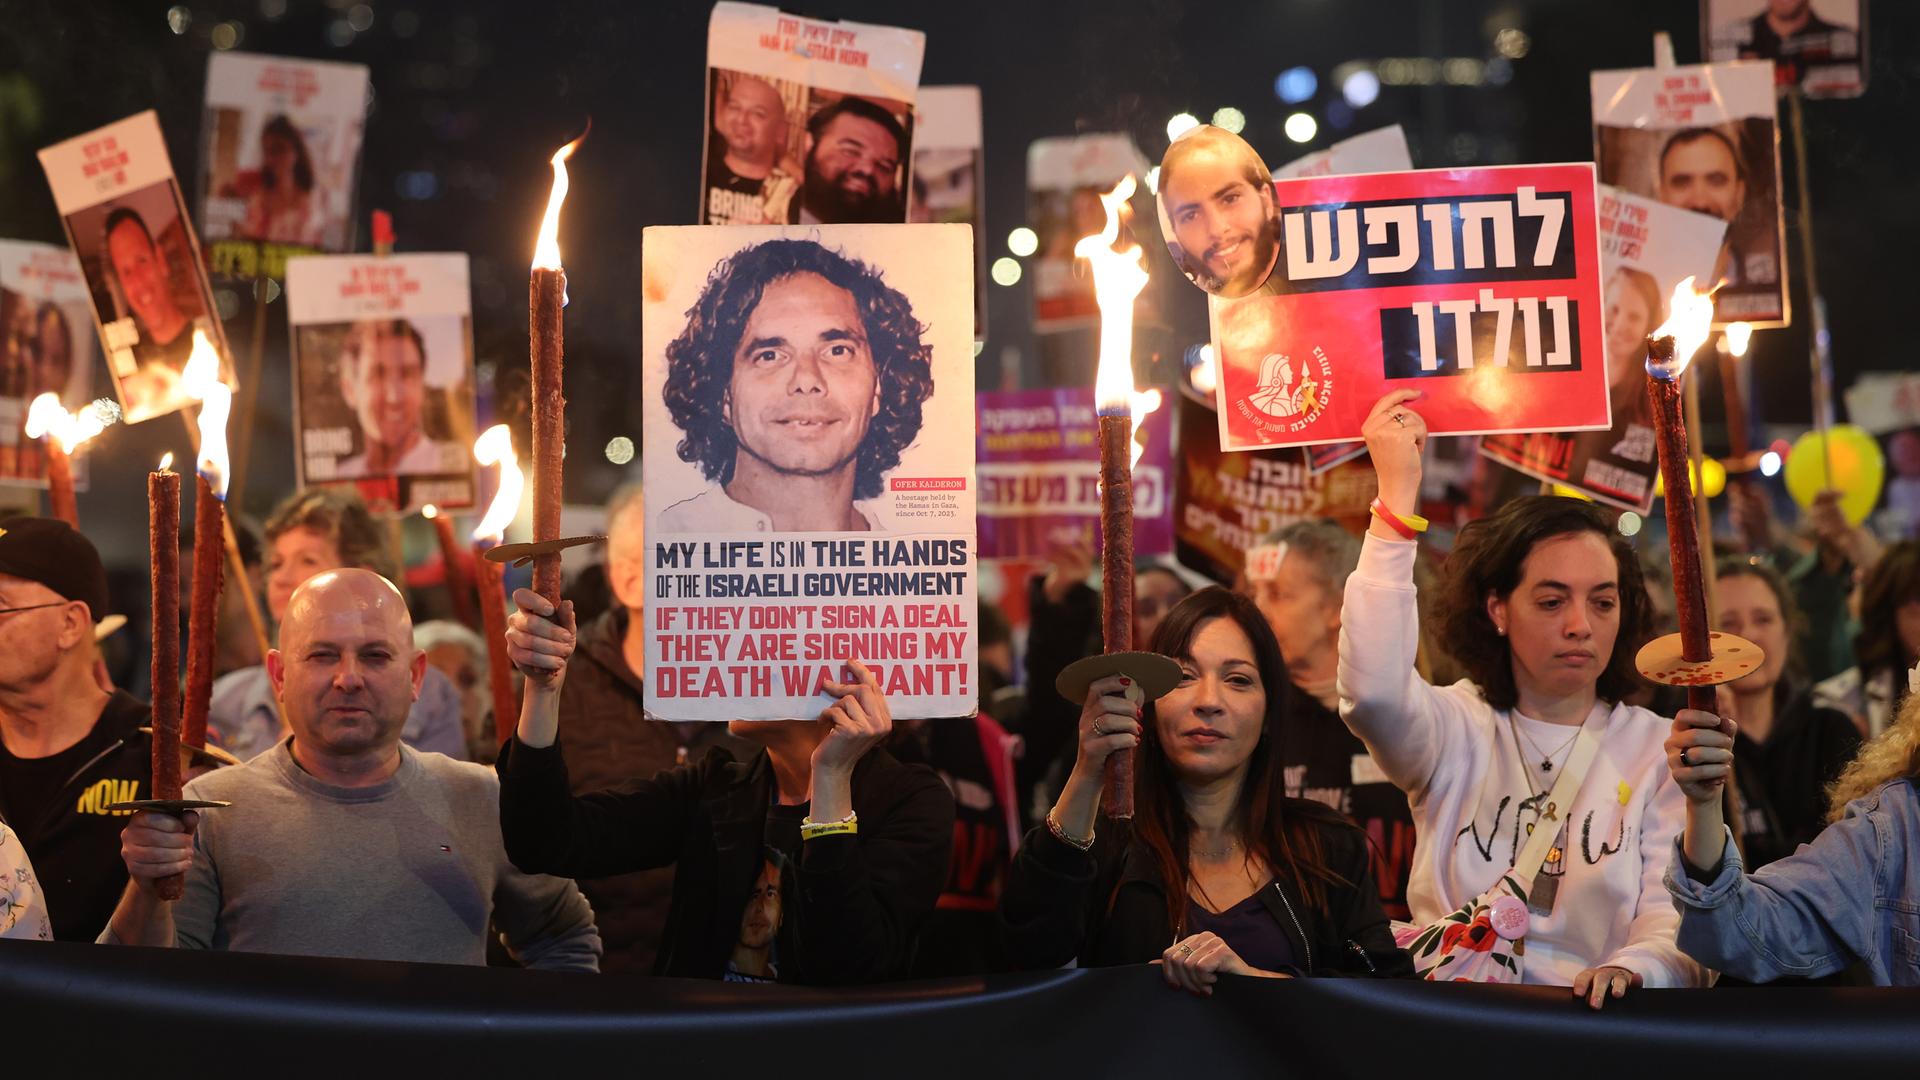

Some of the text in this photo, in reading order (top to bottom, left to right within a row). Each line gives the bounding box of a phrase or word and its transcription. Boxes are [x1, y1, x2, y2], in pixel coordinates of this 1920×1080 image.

[709, 186, 763, 222] BRING
[1284, 186, 1565, 280] לחופש
[1412, 288, 1572, 371] נולדו
[895, 480, 962, 488] OFER KALDERON
[901, 494, 928, 502] hostage
[947, 494, 956, 502] by
[938, 510, 957, 519] 2023.
[941, 502, 959, 510] Gaza,
[656, 539, 967, 569] MY LIFE IS IN THE HANDS
[656, 571, 967, 598] OF THE ISRAELI GOVERNMENT
[656, 604, 967, 631] IF THEY DON'T SIGN A DEAL
[656, 631, 968, 662] THEY ARE SIGNING MY
[656, 665, 771, 698] DEATH
